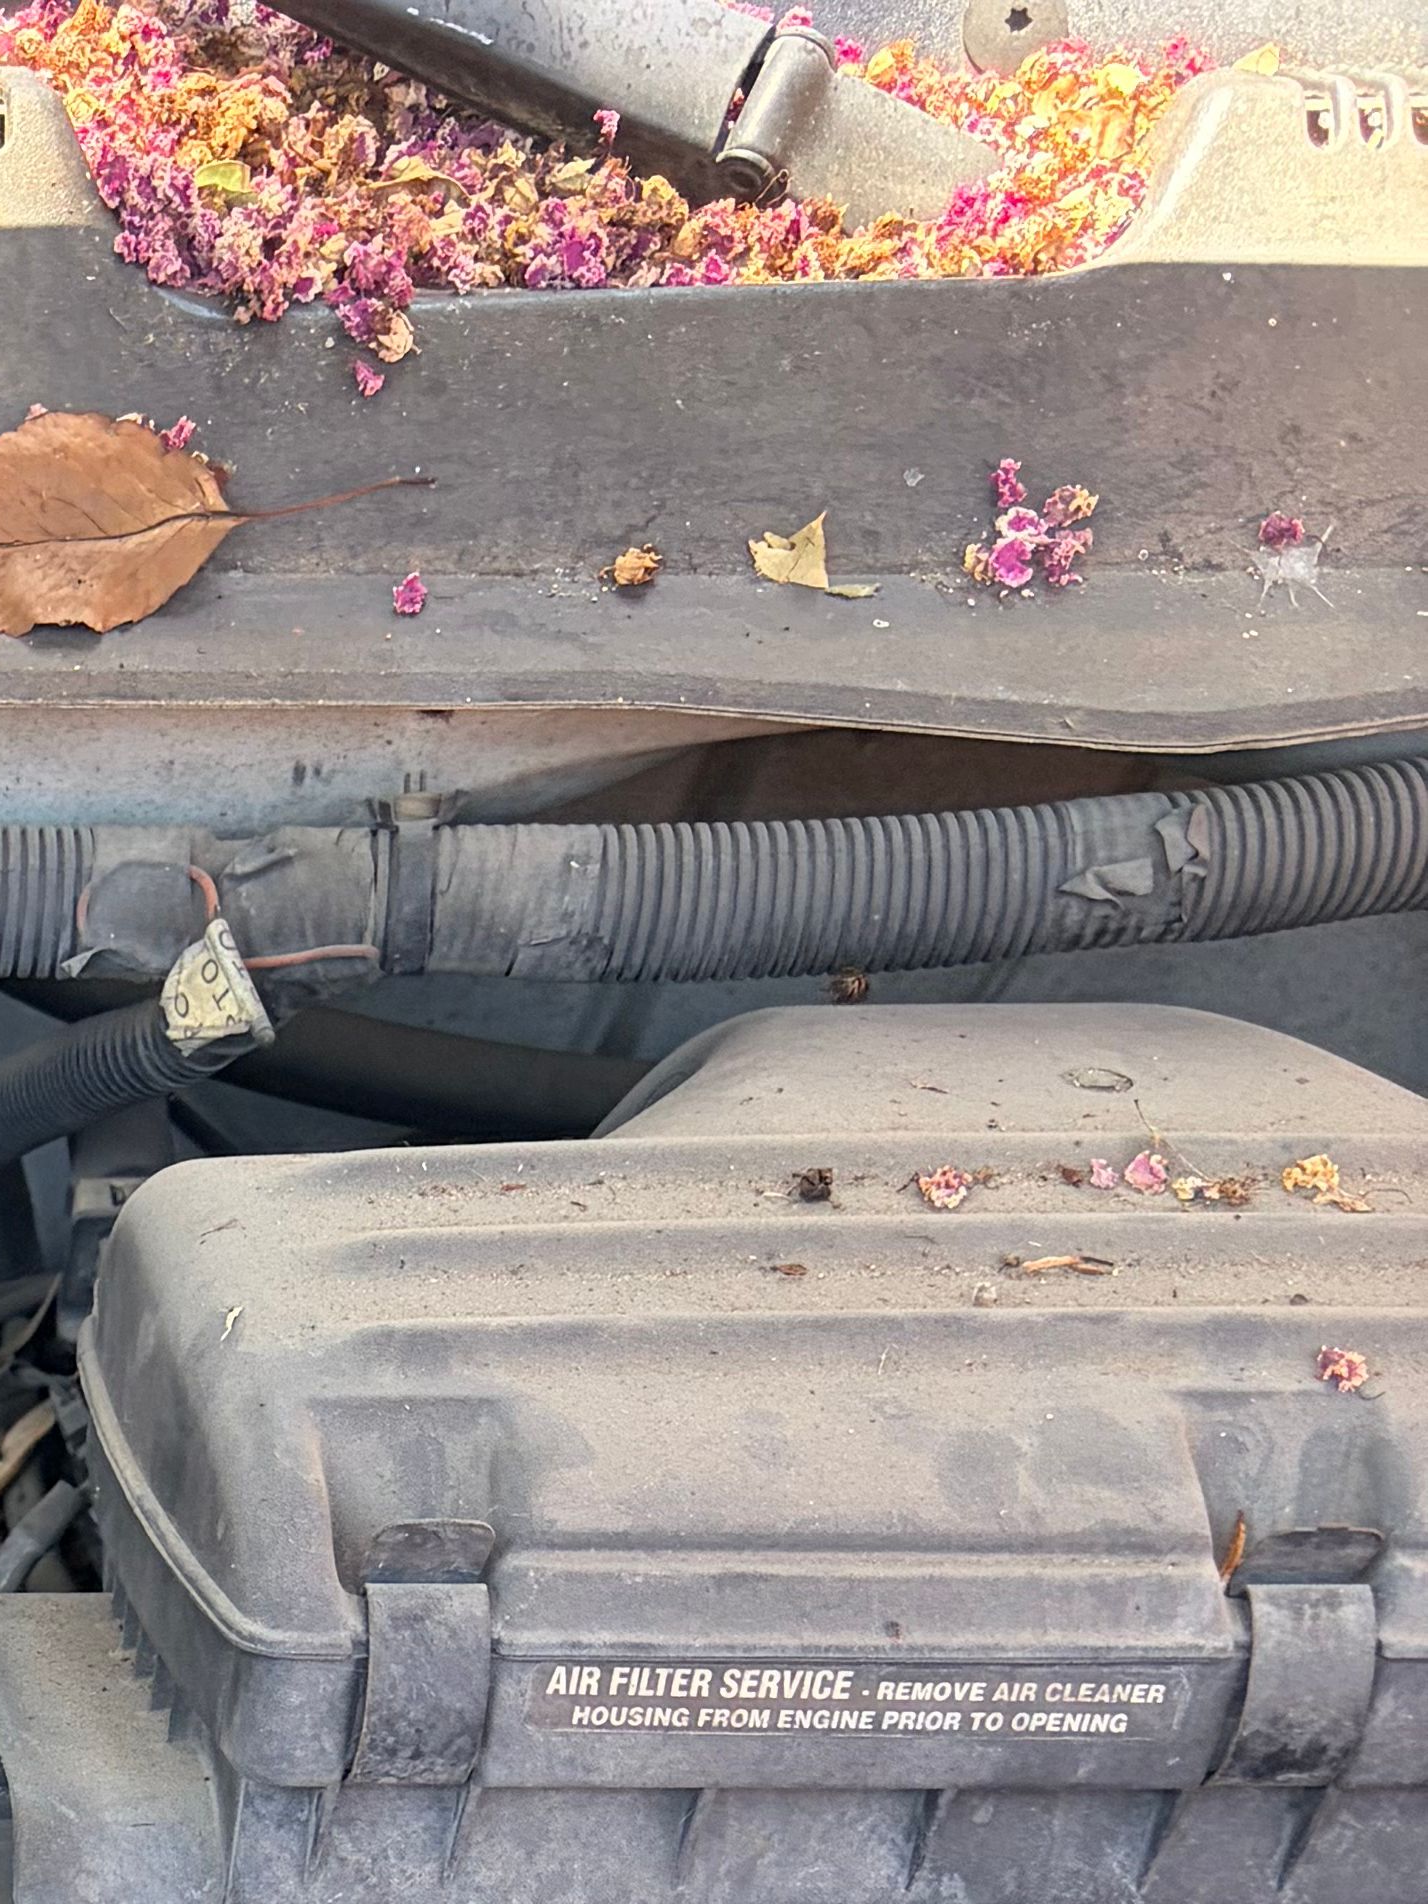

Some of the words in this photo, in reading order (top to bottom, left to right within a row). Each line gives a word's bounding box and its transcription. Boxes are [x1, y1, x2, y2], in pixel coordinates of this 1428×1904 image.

[546, 1666, 599, 1696] AIR
[608, 1667, 711, 1698] FILTER
[719, 1669, 853, 1701] SERVICE
[877, 1682, 985, 1702] REMOVE
[992, 1683, 1037, 1703] AIR
[1044, 1683, 1166, 1705] CLEANER
[571, 1706, 689, 1727] HOUSING
[696, 1707, 770, 1729] FROM
[776, 1708, 874, 1730] ENGINE
[881, 1709, 961, 1731] PRIOR
[969, 1711, 1004, 1731] TO
[1011, 1711, 1128, 1734] OPENING
